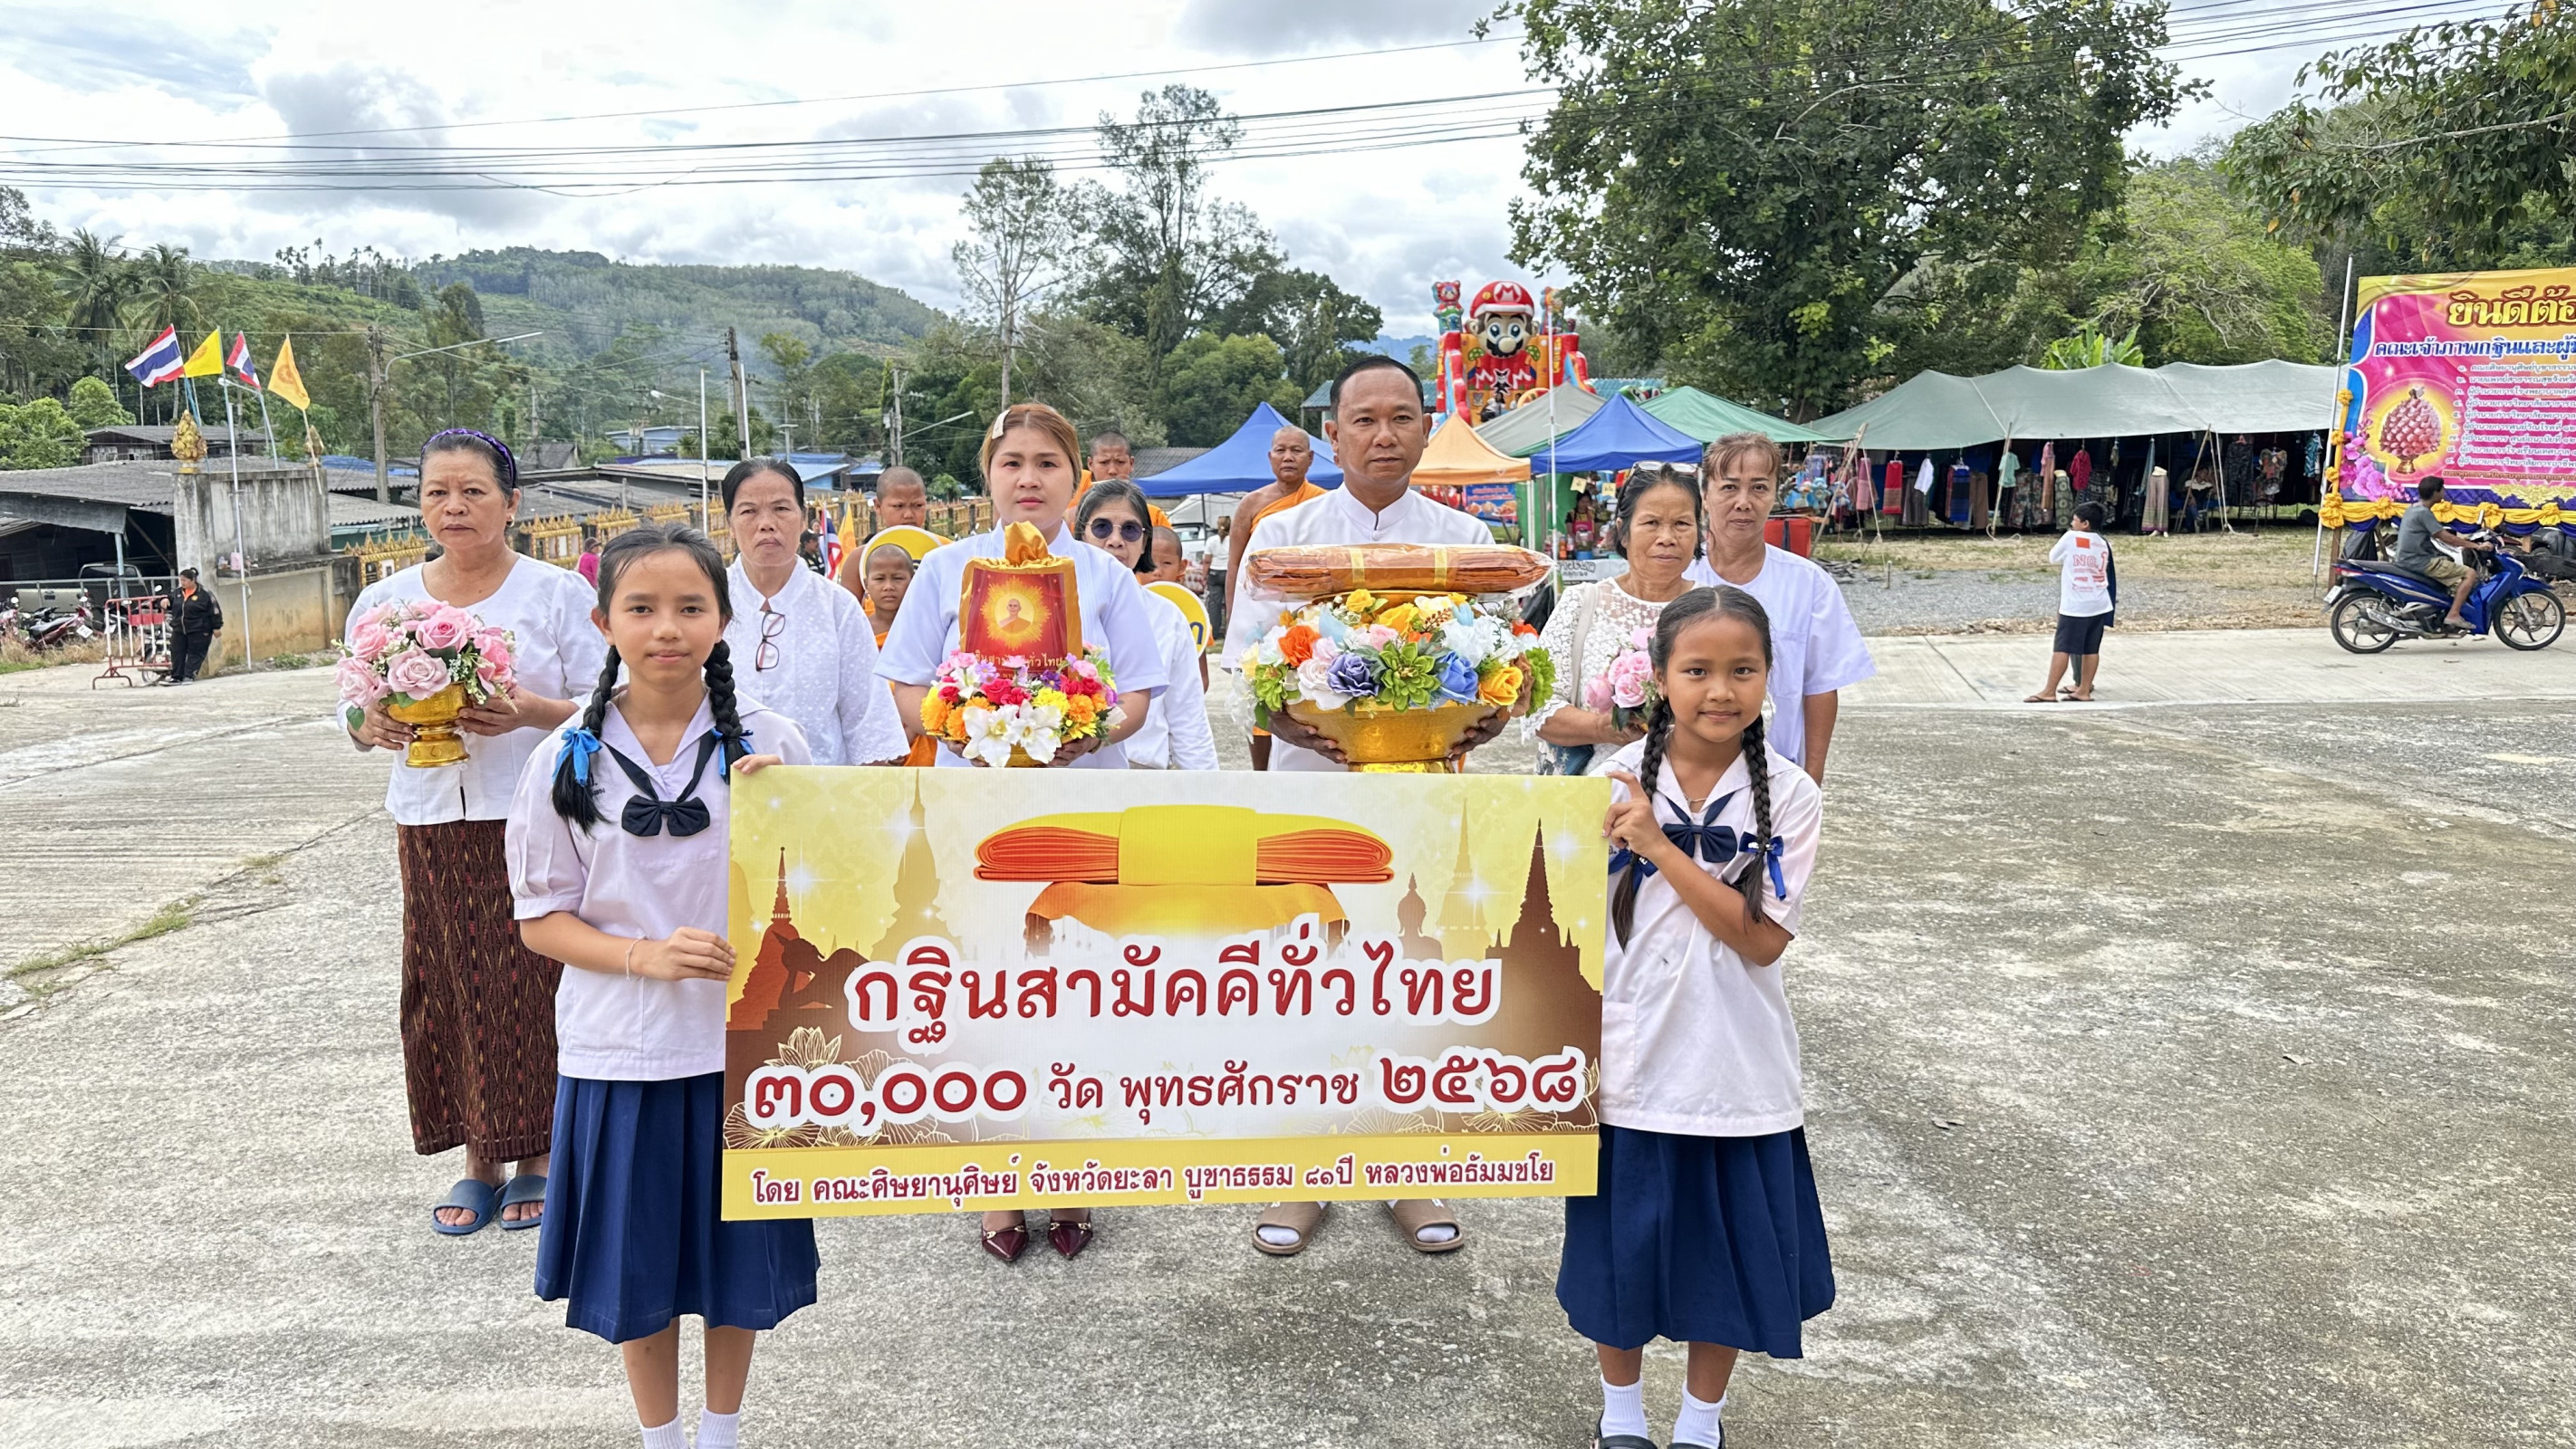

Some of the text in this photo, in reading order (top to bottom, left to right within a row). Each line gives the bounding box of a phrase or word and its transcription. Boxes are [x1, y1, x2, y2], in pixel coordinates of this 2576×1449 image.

[2447, 287, 2576, 326] ยินดีต้อ
[855, 923, 1493, 1043] กฐินสามัคคีทั่วไทย
[755, 1055, 1578, 1126] ๓๐,๐๐๐ วัด พุทธศักราช ๒๕๖๘
[754, 1171, 799, 1203] โดย
[814, 1155, 1020, 1206] คณะศิษยานุศิษย์
[1030, 1162, 1173, 1195] จังหวัดยะลา
[1186, 1165, 1293, 1198] บูชาธรรม
[1366, 1147, 1554, 1184] หลวงพ่อธัมมชโย
